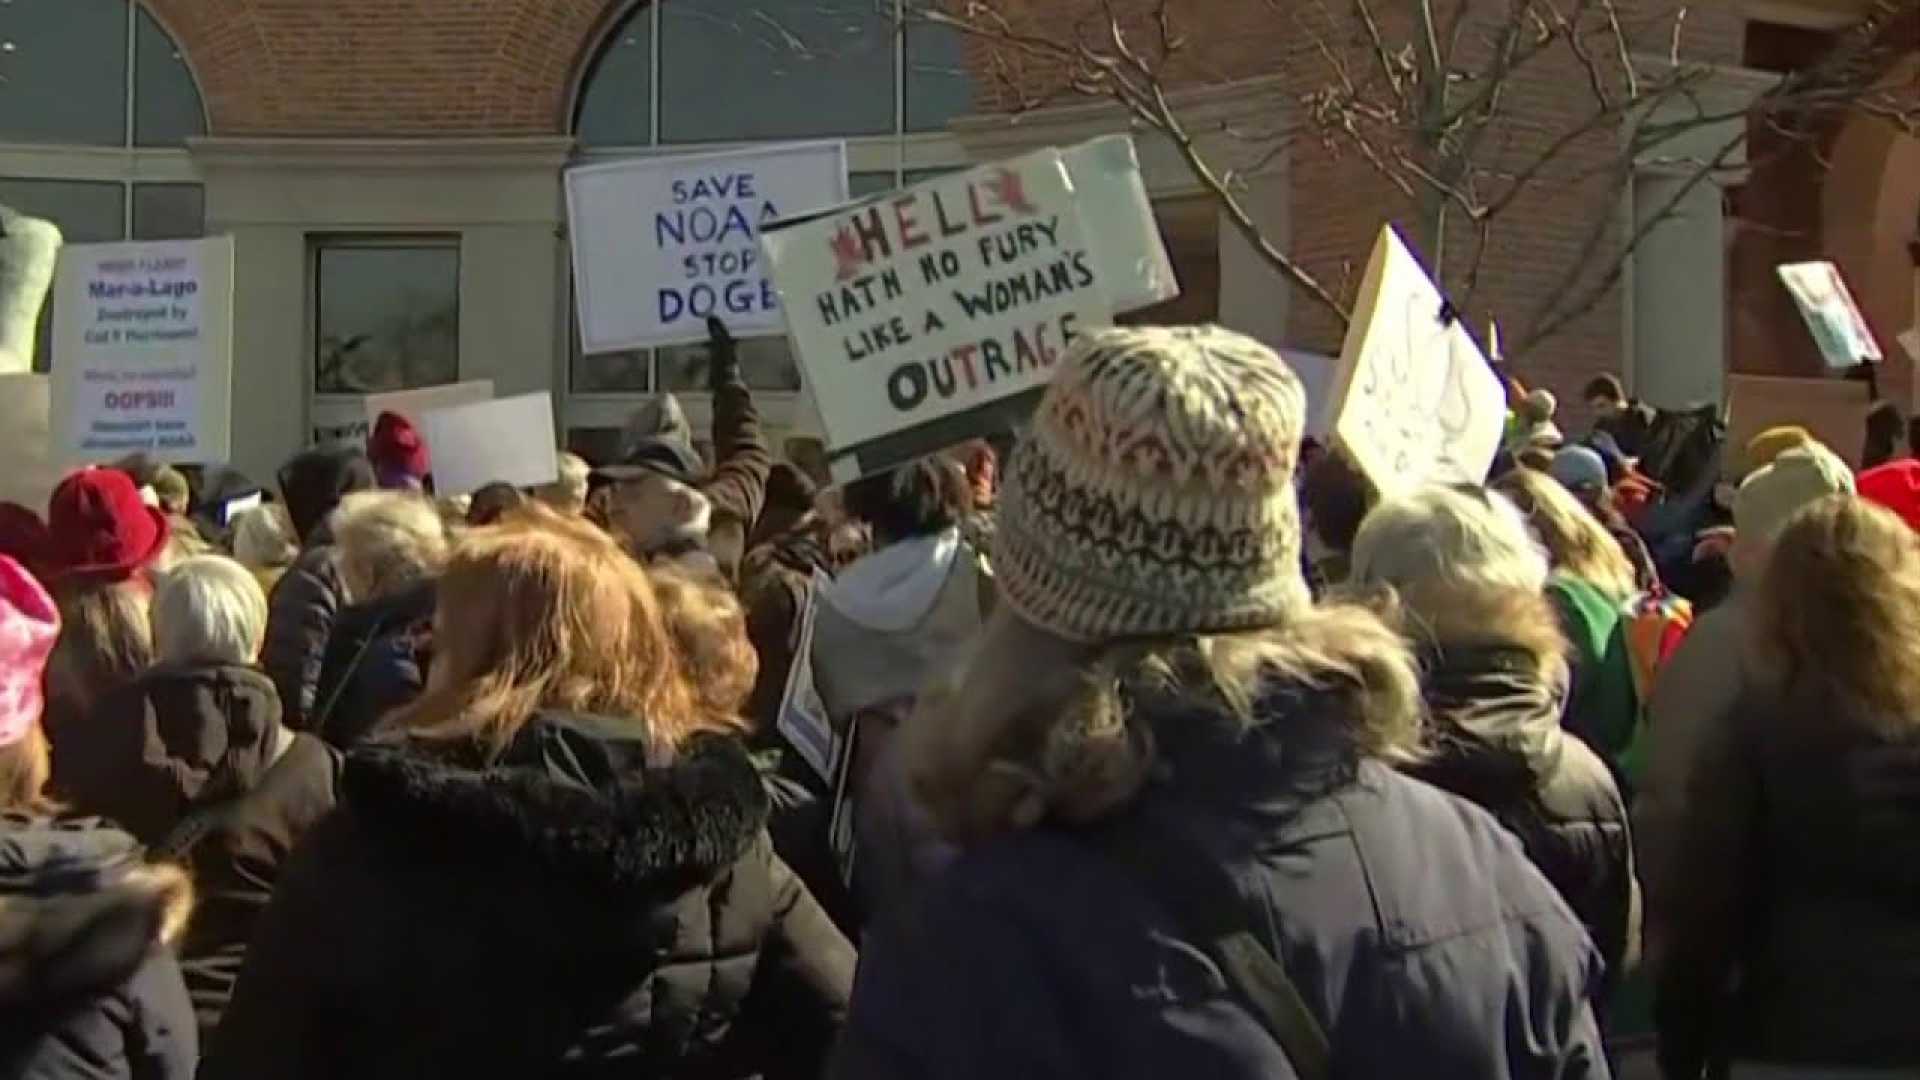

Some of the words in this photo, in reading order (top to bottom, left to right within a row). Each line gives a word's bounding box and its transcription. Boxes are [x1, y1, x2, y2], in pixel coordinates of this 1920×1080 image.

[672, 174, 756, 204] SAVE
[852, 183, 1003, 262] HELL
[683, 249, 755, 278] STOP
[816, 268, 903, 326] HATH
[919, 250, 960, 285] NO
[979, 216, 1059, 268] FURY
[88, 279, 198, 299] Mar-a-Lago
[658, 279, 776, 324] DOGE
[844, 317, 912, 362] LIKE
[924, 311, 944, 335] A
[954, 250, 1094, 320] WOMAN'S
[887, 312, 1080, 412] OUTRAGE
[104, 390, 176, 411] OOPS!!!
